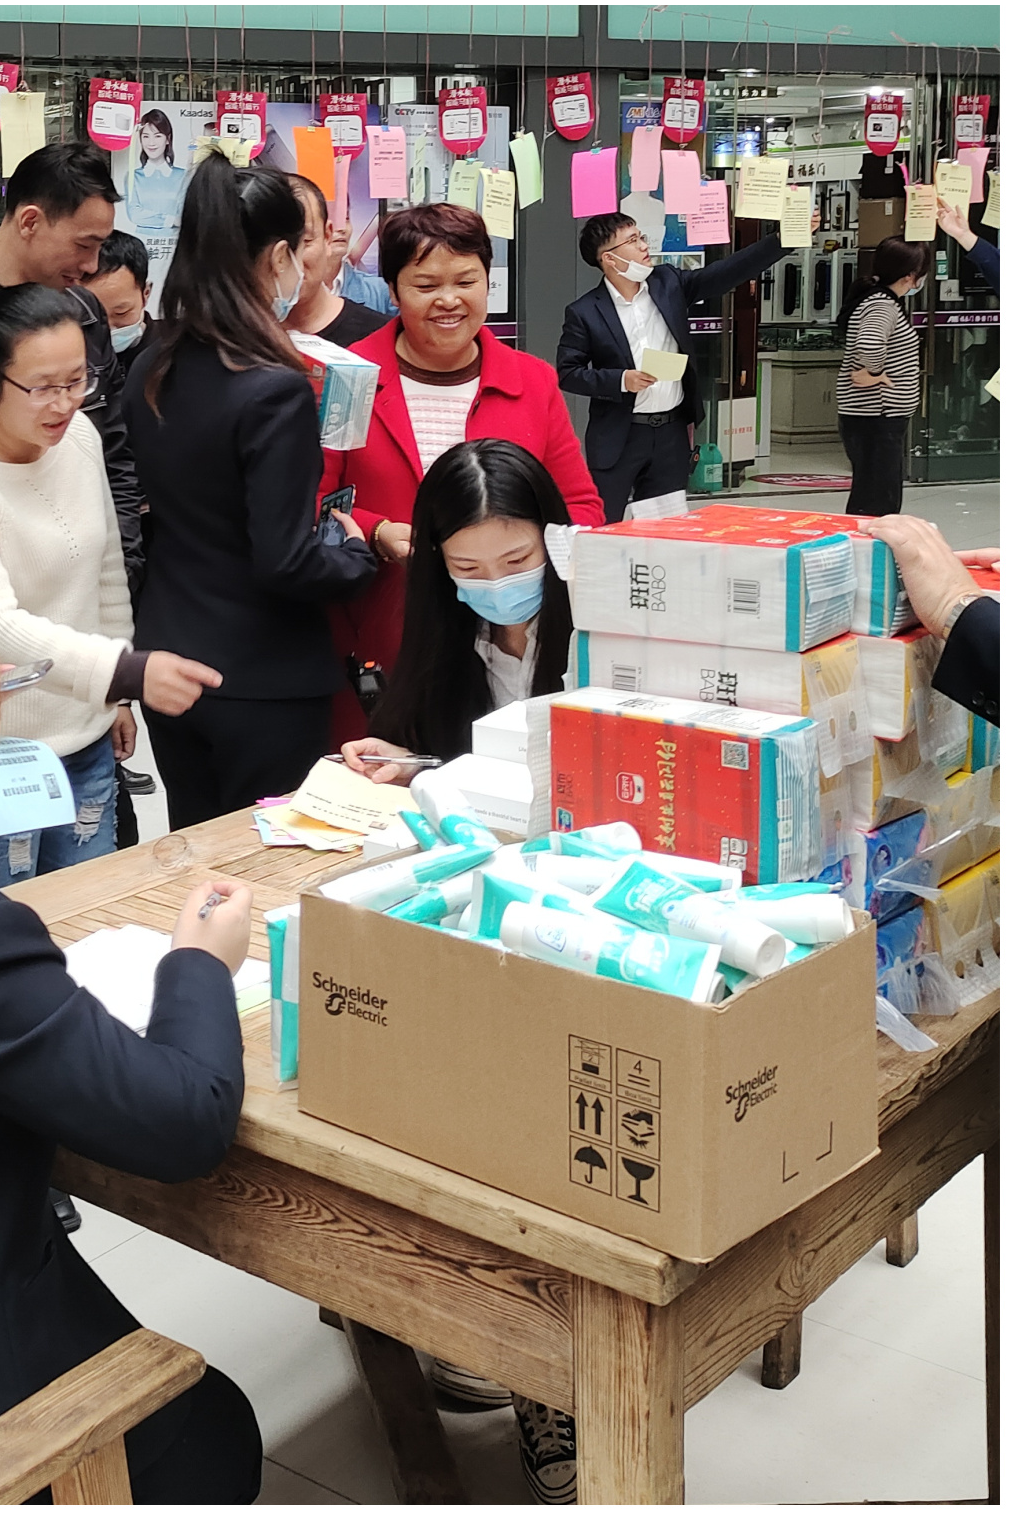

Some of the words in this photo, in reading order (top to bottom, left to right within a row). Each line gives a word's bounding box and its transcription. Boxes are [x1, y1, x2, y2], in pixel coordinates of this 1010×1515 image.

[180, 109, 214, 118] Kaadas
[394, 108, 415, 116] CCTV
[651, 564, 666, 612] BABO
[699, 668, 716, 703] BAB
[312, 971, 388, 1011] Schneider
[347, 1001, 388, 1027] Electric
[633, 1060, 643, 1074] 4
[725, 1064, 778, 1105] Schneider
[749, 1083, 778, 1107] Electric
